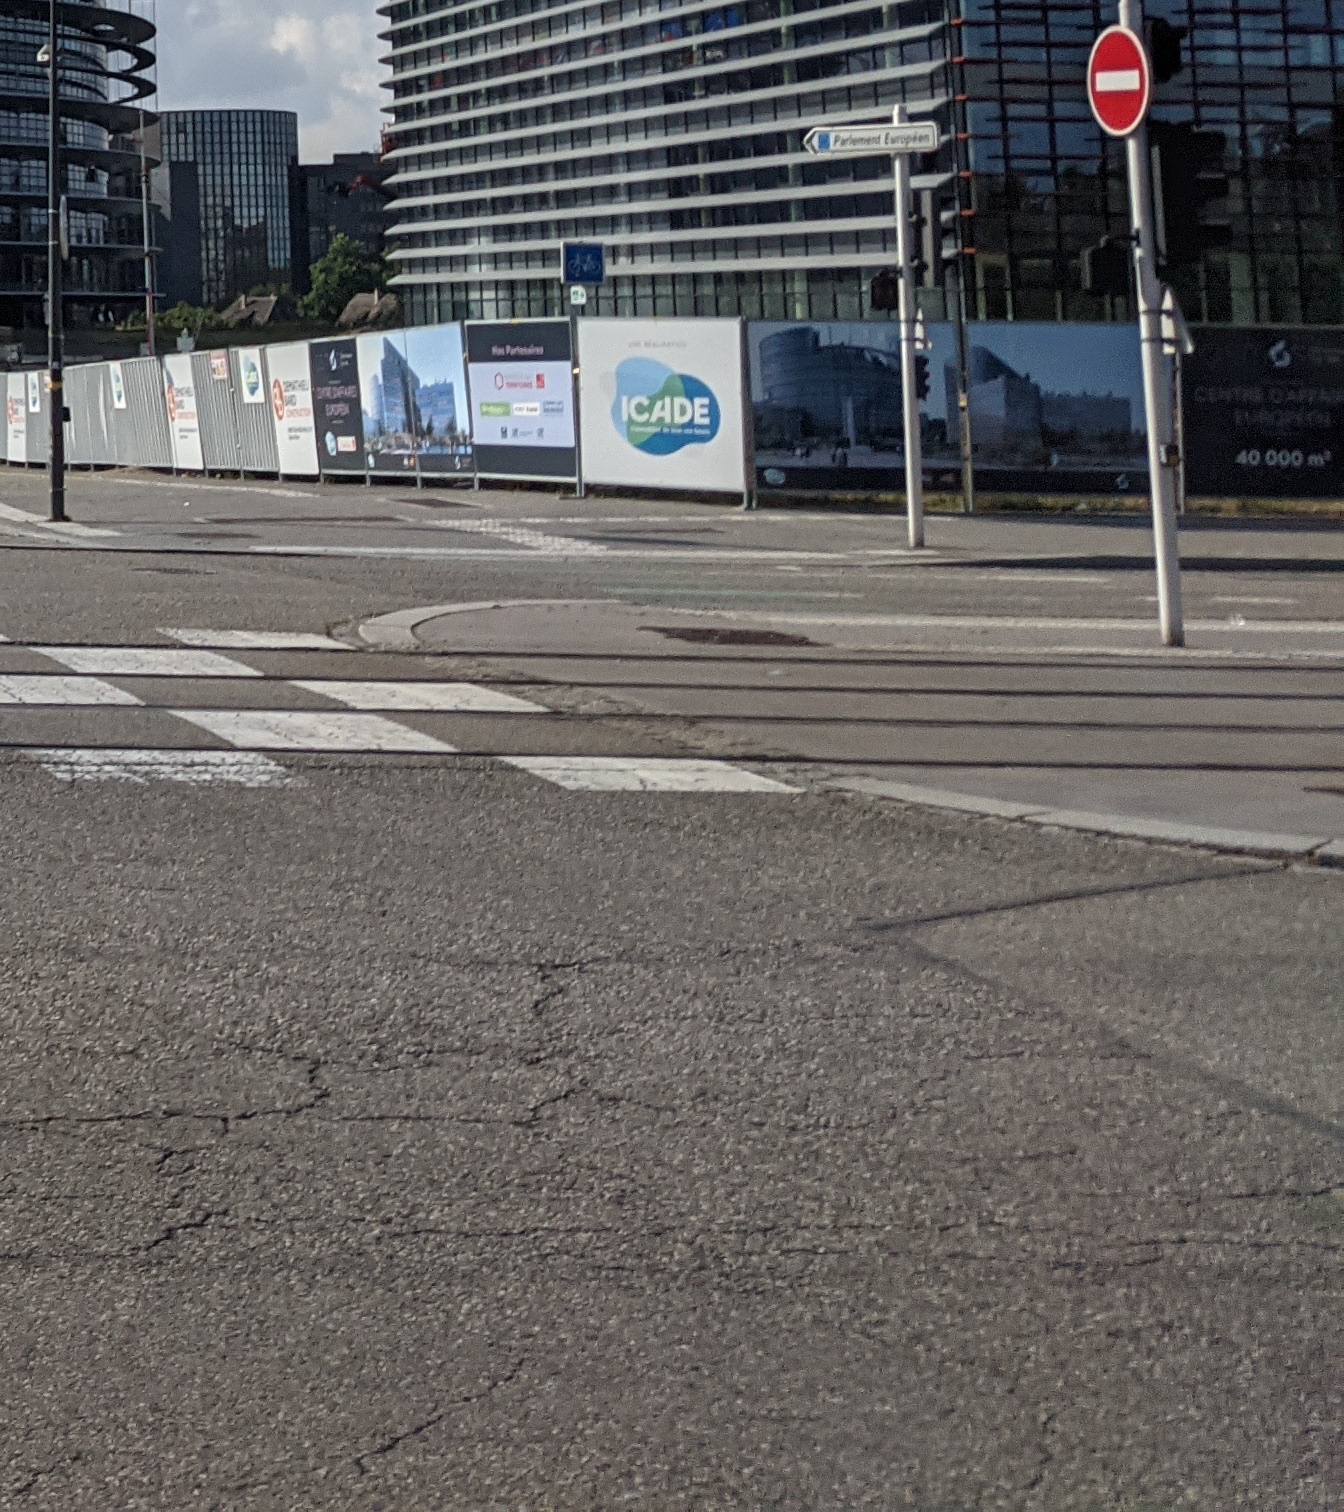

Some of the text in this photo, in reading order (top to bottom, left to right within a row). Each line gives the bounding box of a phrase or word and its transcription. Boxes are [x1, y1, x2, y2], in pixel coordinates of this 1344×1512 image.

[833, 131, 931, 148] Parlement Européen
[621, 395, 711, 425] ICADE
[1235, 449, 1261, 466] 40
[1264, 449, 1304, 467] 000
